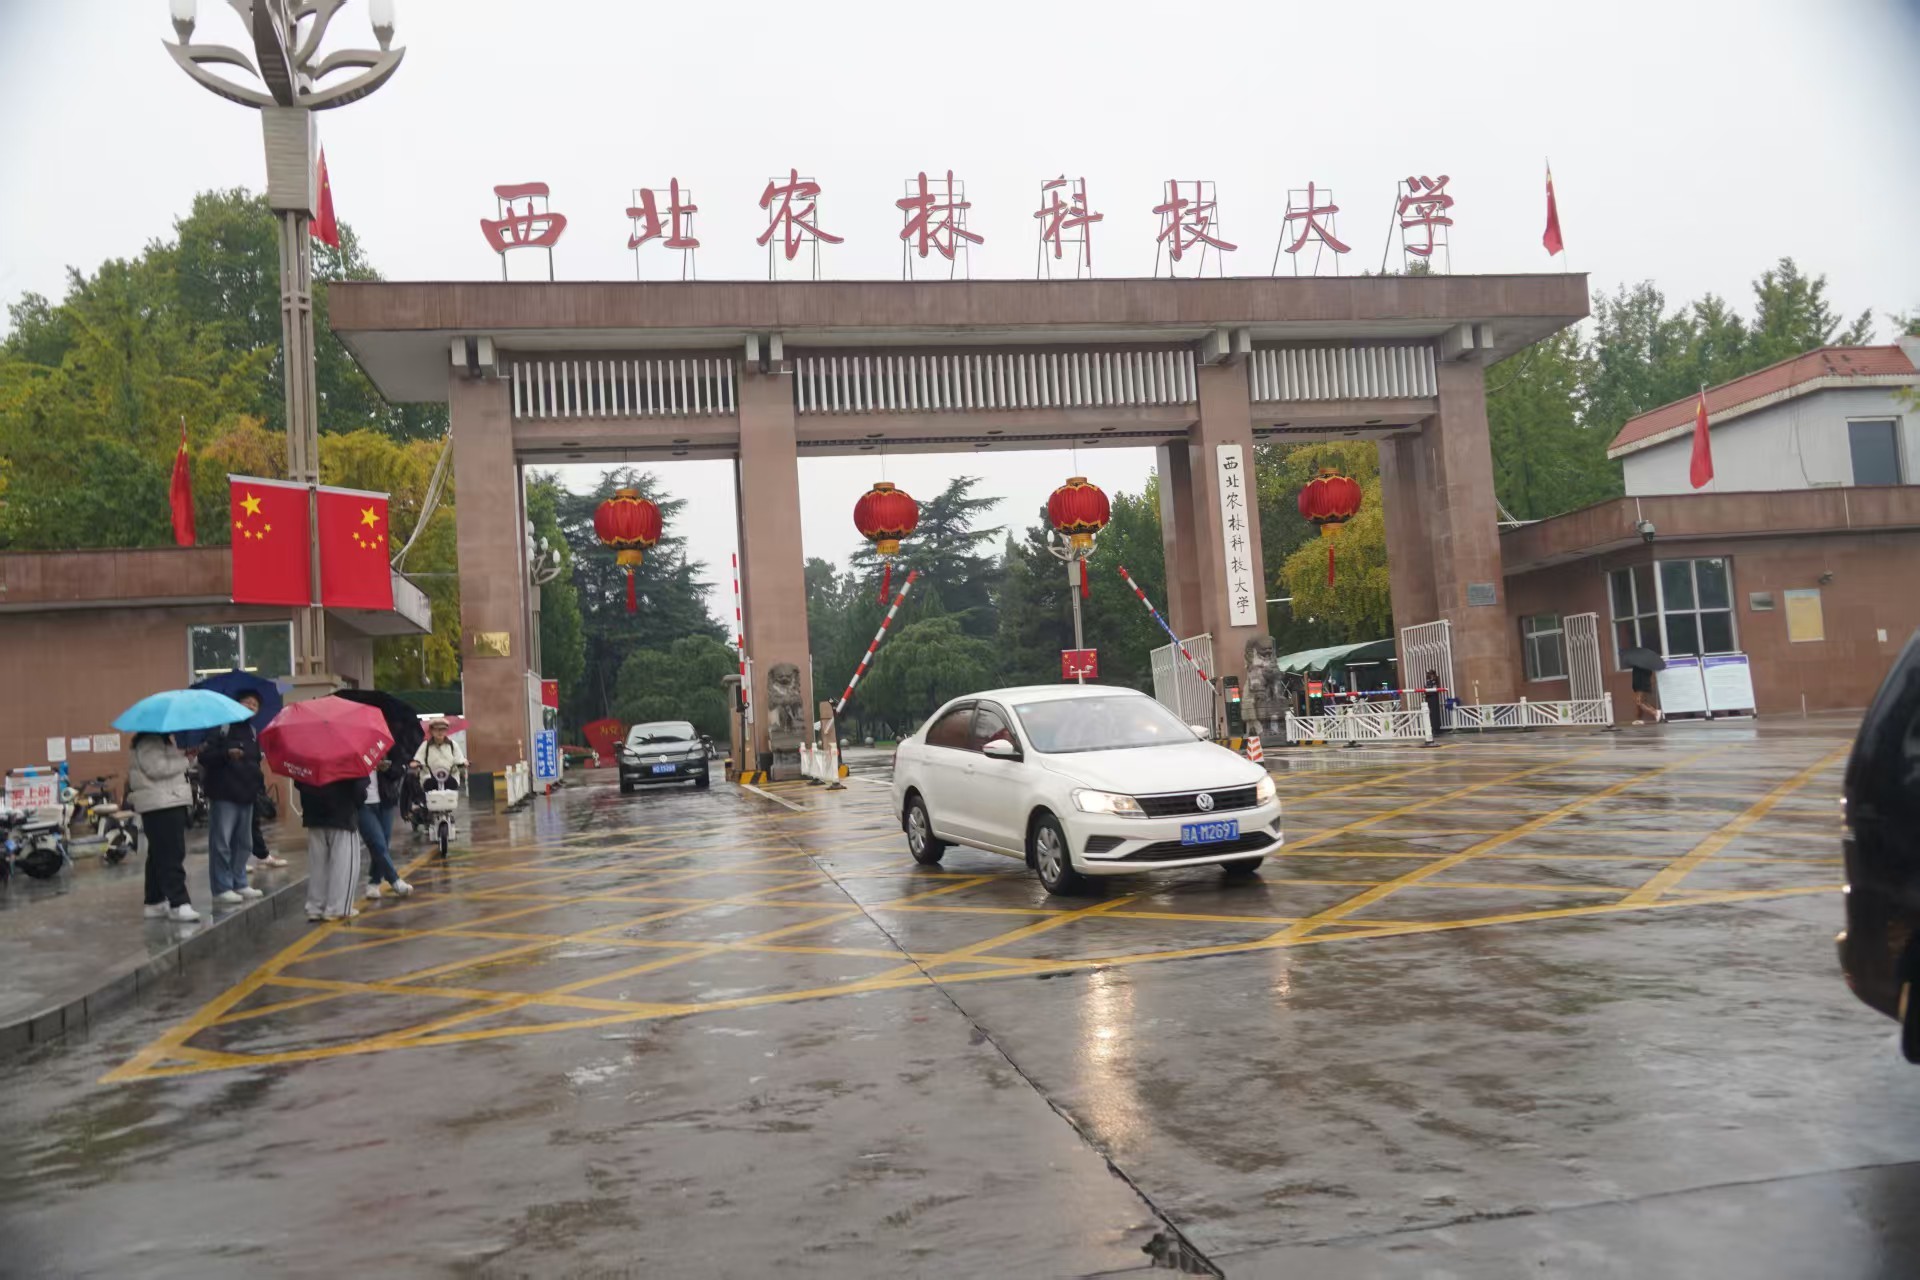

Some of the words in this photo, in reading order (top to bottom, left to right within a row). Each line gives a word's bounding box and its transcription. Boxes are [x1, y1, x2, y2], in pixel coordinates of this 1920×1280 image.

[480, 168, 1454, 267] 西北农林科技大学
[1223, 456, 1249, 614] 西北农林科技大学
